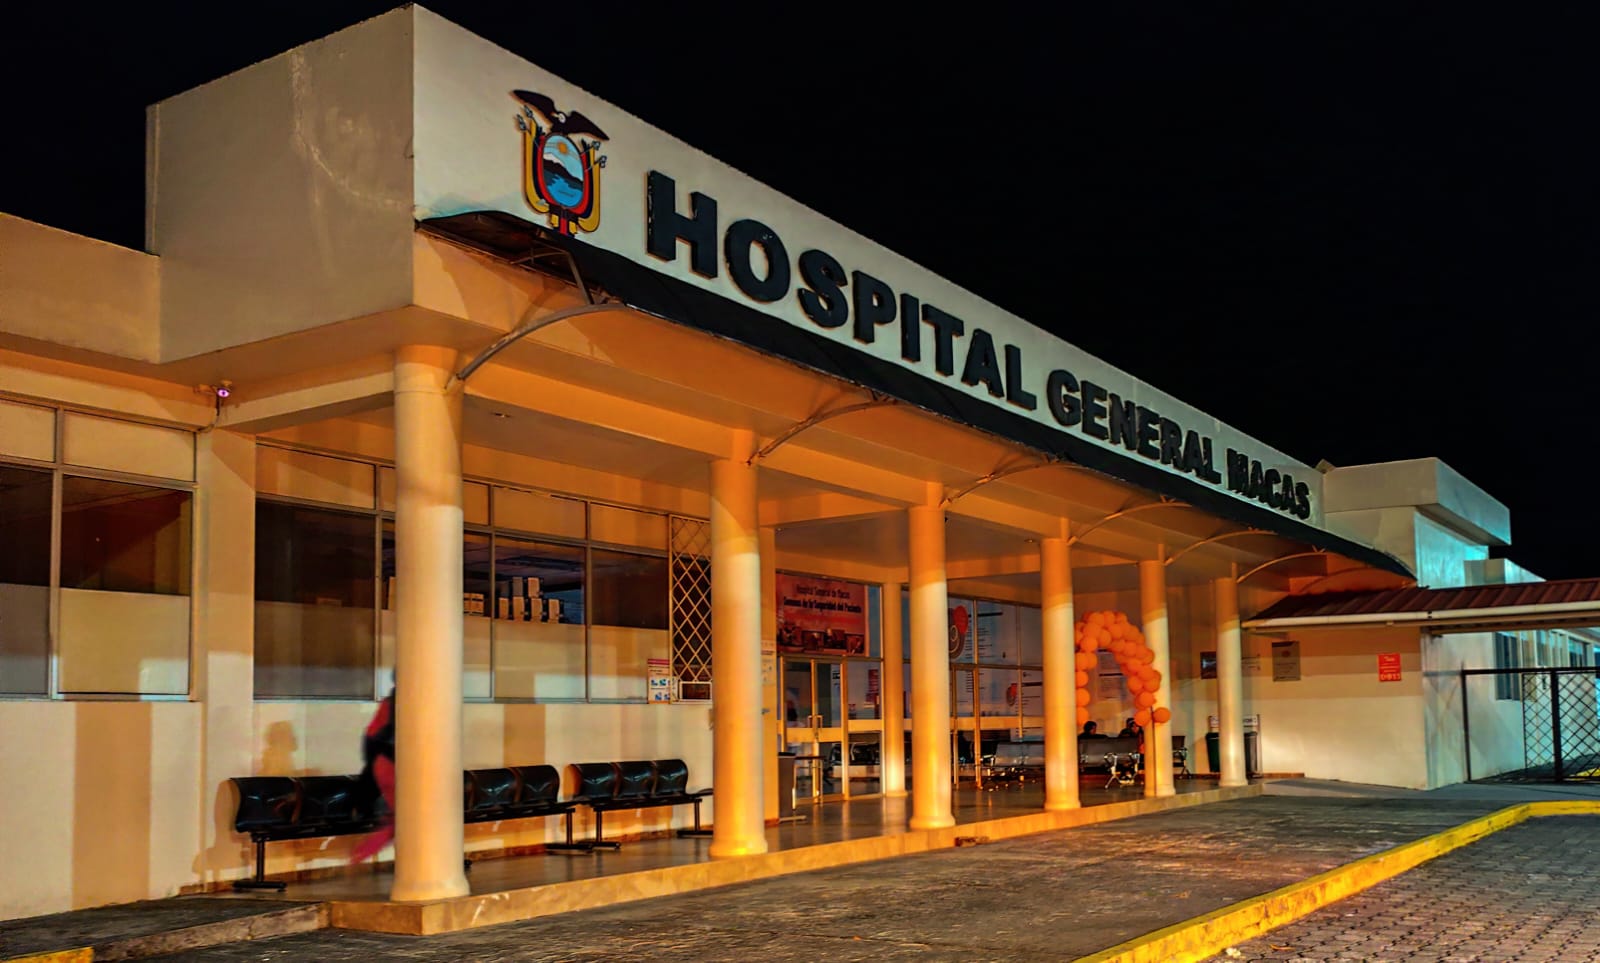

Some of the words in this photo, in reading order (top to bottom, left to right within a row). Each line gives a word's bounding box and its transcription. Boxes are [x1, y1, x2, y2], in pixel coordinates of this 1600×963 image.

[646, 169, 1037, 411] HOSPITAL
[1047, 369, 1221, 484] GENERAL
[1227, 447, 1311, 520] MACAS
